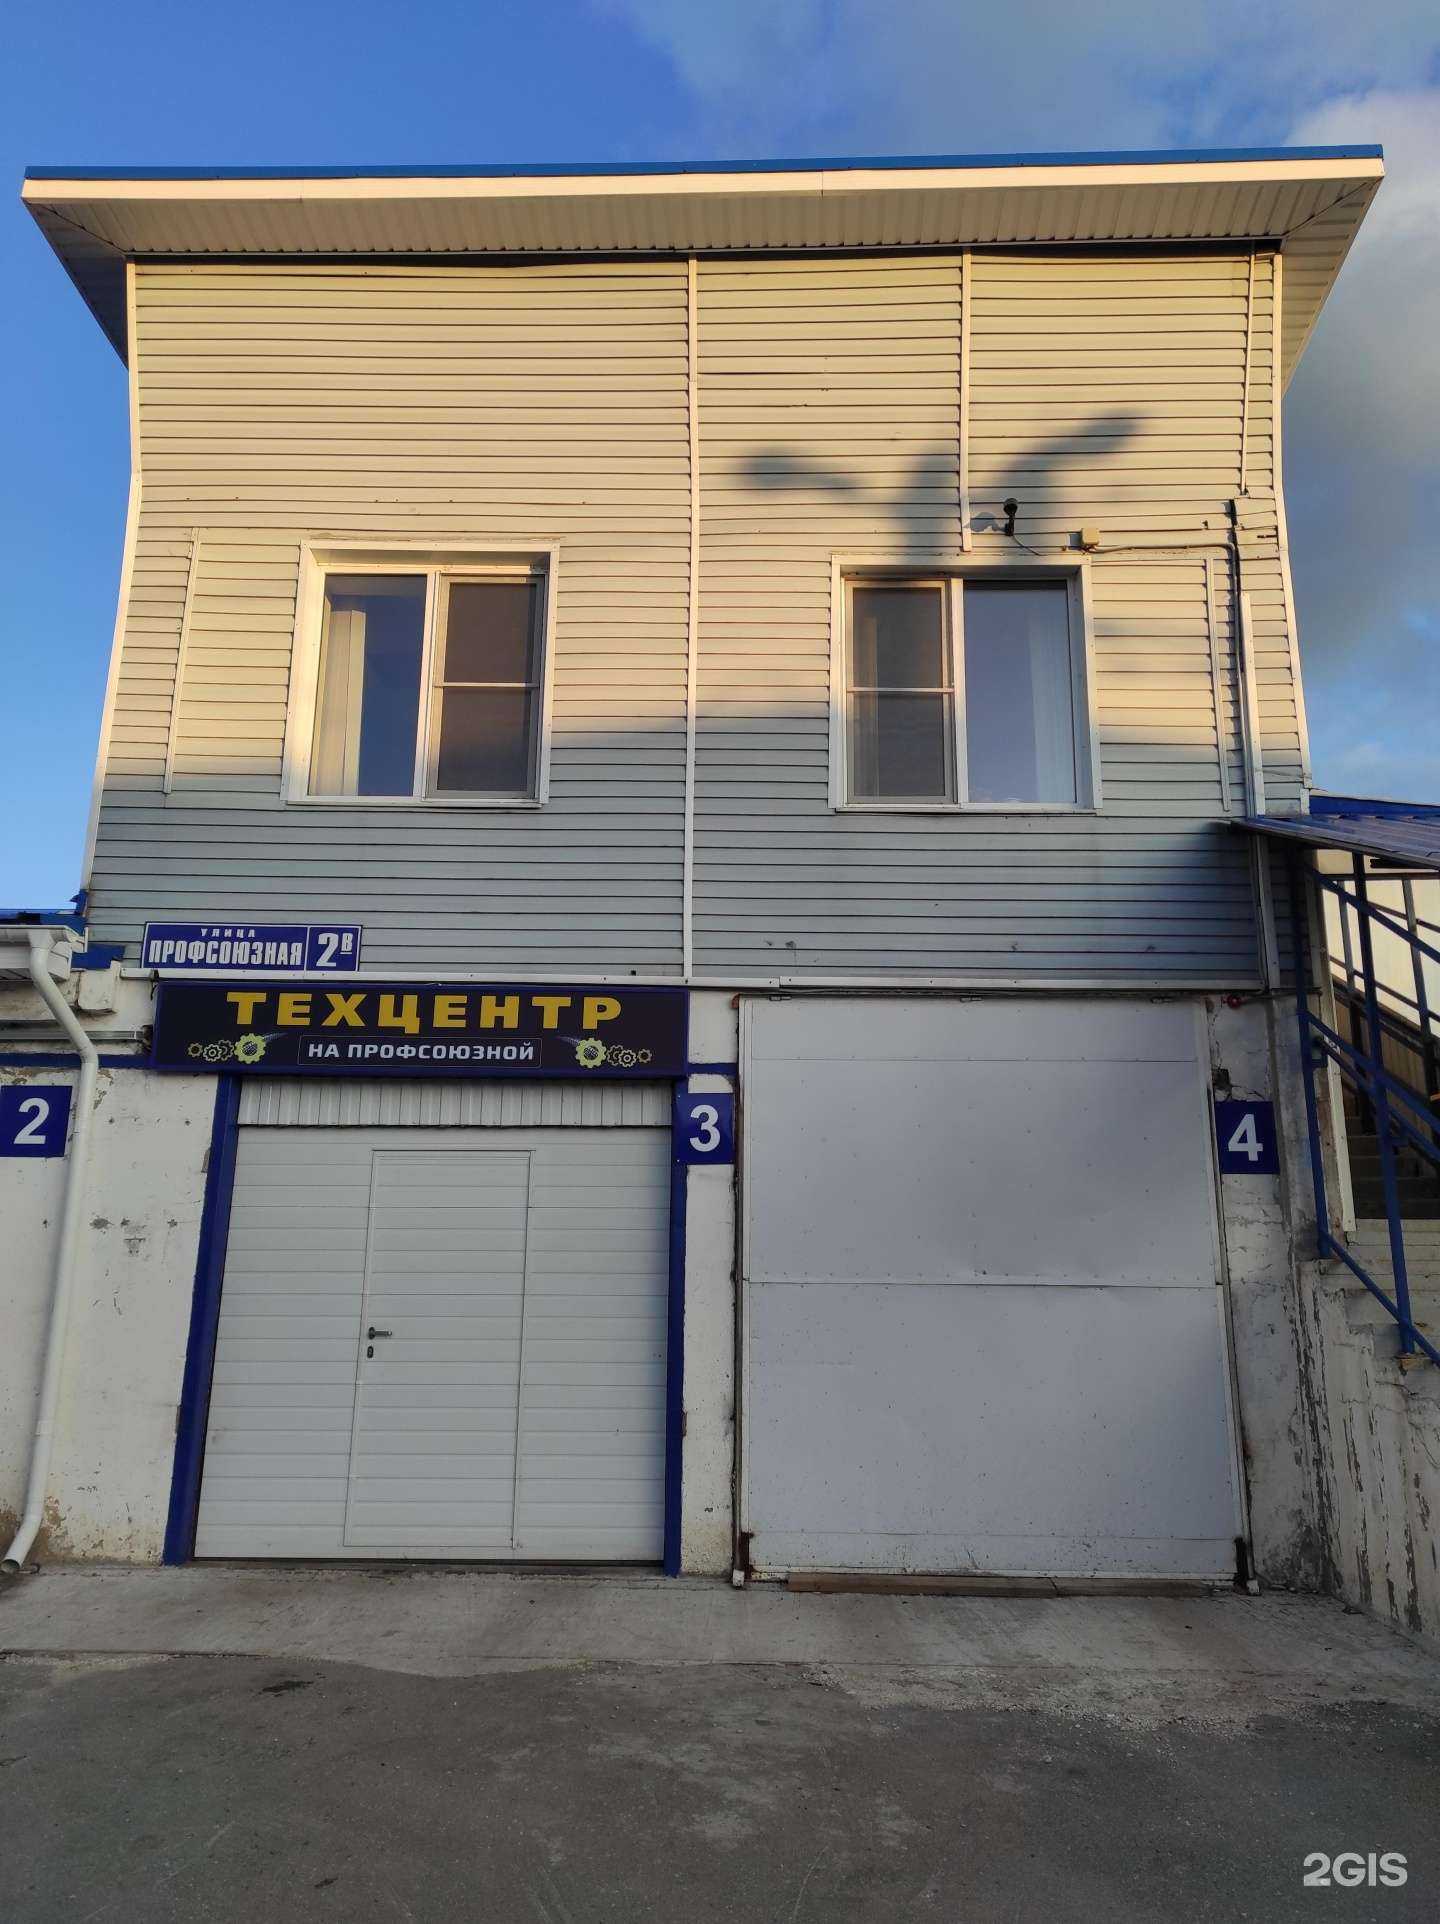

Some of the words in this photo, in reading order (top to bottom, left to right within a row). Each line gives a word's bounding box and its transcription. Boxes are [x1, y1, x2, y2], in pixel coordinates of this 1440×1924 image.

[148, 940, 304, 966] ПРОФСОЮЗНАЯ
[200, 928, 256, 938] УЛИЦА
[226, 991, 623, 1034] ТЕХЦЕНТР
[308, 1043, 342, 1058] НА
[347, 1041, 534, 1060] ПРОФСОЮЗНОЙ
[13, 1097, 50, 1145] 2
[689, 1104, 721, 1152] 3
[1228, 1113, 1264, 1162] 4
